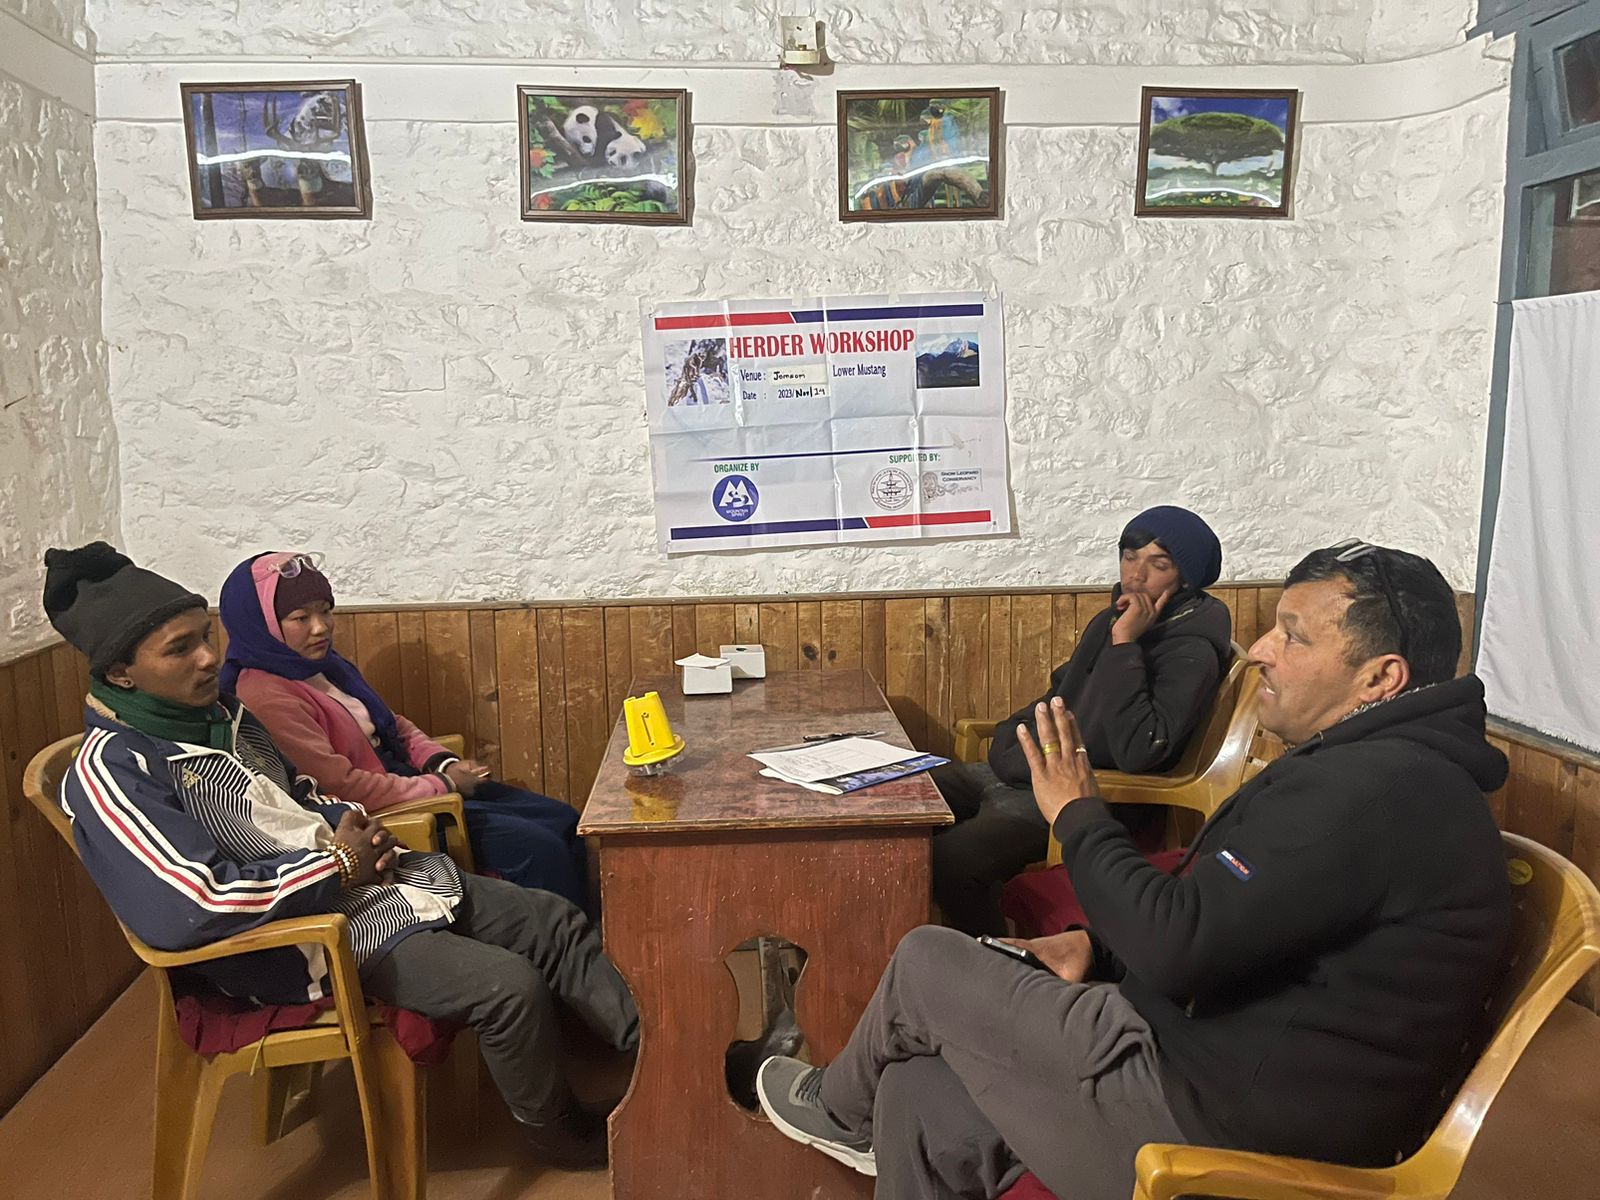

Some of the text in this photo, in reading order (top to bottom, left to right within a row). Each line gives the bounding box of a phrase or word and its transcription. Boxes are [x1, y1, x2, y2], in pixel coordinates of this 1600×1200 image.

[729, 329, 915, 358] HERDER WORKSHOP
[833, 364, 855, 377] Lower
[857, 364, 887, 378] Mustang
[929, 453, 941, 462] BY:
[714, 462, 760, 473] ORGANIZE BY
